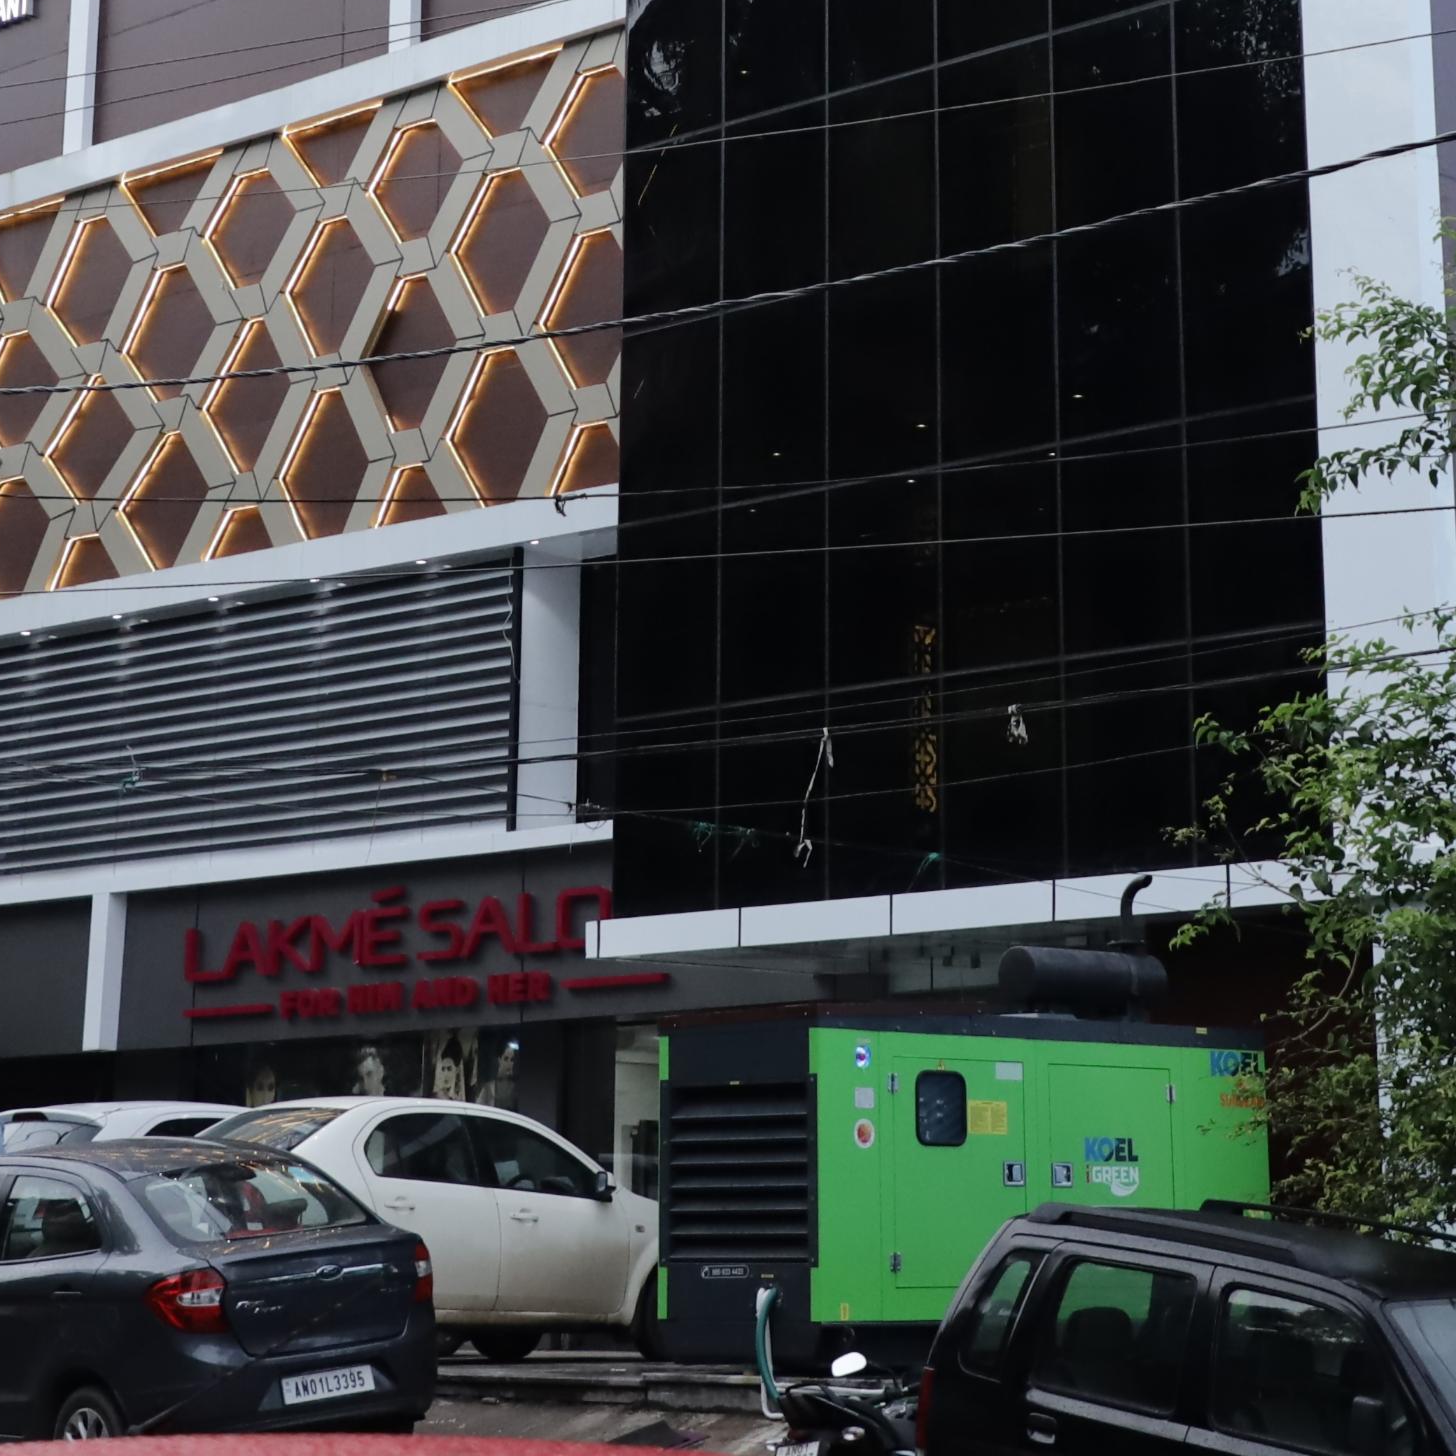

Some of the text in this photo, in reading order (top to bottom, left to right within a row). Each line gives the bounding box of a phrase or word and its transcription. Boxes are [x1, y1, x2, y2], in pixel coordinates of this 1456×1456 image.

[184, 884, 410, 983] LAKMÉ
[279, 970, 551, 1020] FOR HIM AND HER
[1210, 1050, 1264, 1077] KOEL
[1084, 1136, 1139, 1163] KOEL
[295, 1370, 365, 1399] AN01L3395
